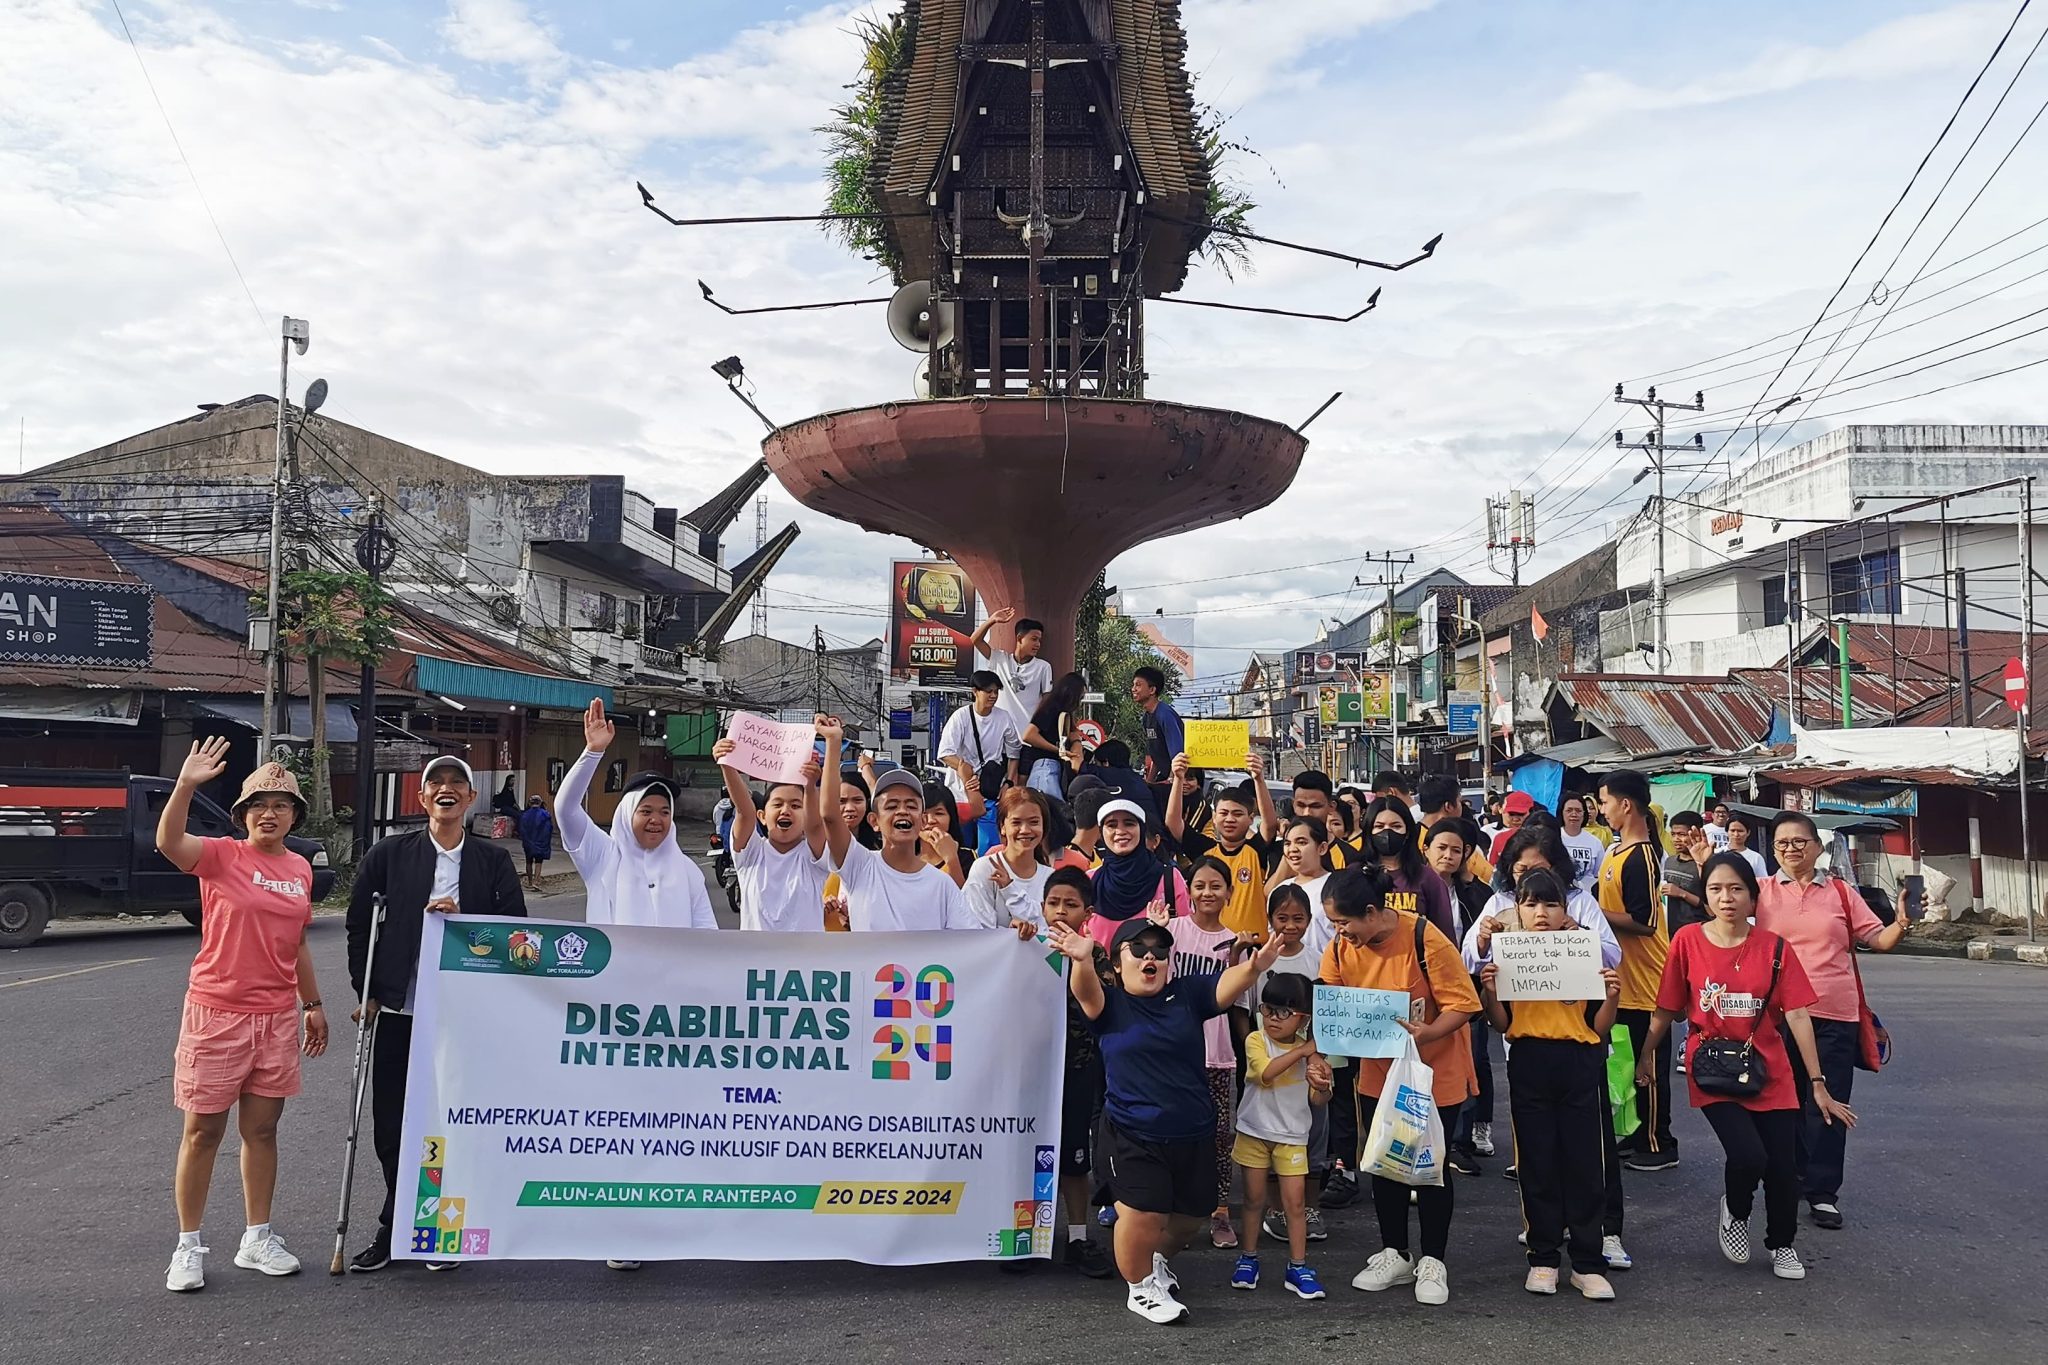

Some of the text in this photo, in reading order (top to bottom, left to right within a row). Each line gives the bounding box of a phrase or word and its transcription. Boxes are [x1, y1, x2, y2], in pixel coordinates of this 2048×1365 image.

[6, 629, 57, 643] SHOP
[914, 636, 954, 644] TANPA FILTER
[743, 720, 811, 742] SAYANGI DAN
[1198, 734, 1231, 744] UNTUK
[737, 732, 797, 757] HARGAILAH
[750, 752, 785, 772] KAMI
[1572, 848, 1591, 860] ONE
[1500, 934, 1591, 946] TERBATAS bukan
[1544, 948, 1562, 958] tak
[1567, 947, 1592, 958] bisa
[1517, 962, 1559, 974] meraih
[746, 969, 851, 1002] HARI
[874, 963, 955, 1019] 20
[1511, 979, 1561, 992] IMPIAN
[1317, 988, 1391, 1006] DISABILITAS
[565, 1002, 851, 1041] DISABILITAS
[1317, 1005, 1351, 1018] adalah
[1356, 1007, 1387, 1024] bagian
[1321, 1023, 1403, 1041] KERAGAMAN
[560, 1040, 850, 1071] INTERNASIONAL
[872, 1024, 952, 1080] 24
[722, 1087, 782, 1104] TEMA:
[447, 1107, 1036, 1134] MEMPERKUAT KEPEMIMPINAN PENYANDANG DISABILITAS UNTUK
[505, 1136, 983, 1160] MASA DEPAN YANG INKLUSIF DAN BERKELANJUTAN
[538, 1187, 952, 1206] ALUN-ALUN KOTA RANTEPAO 20 DES 2024
